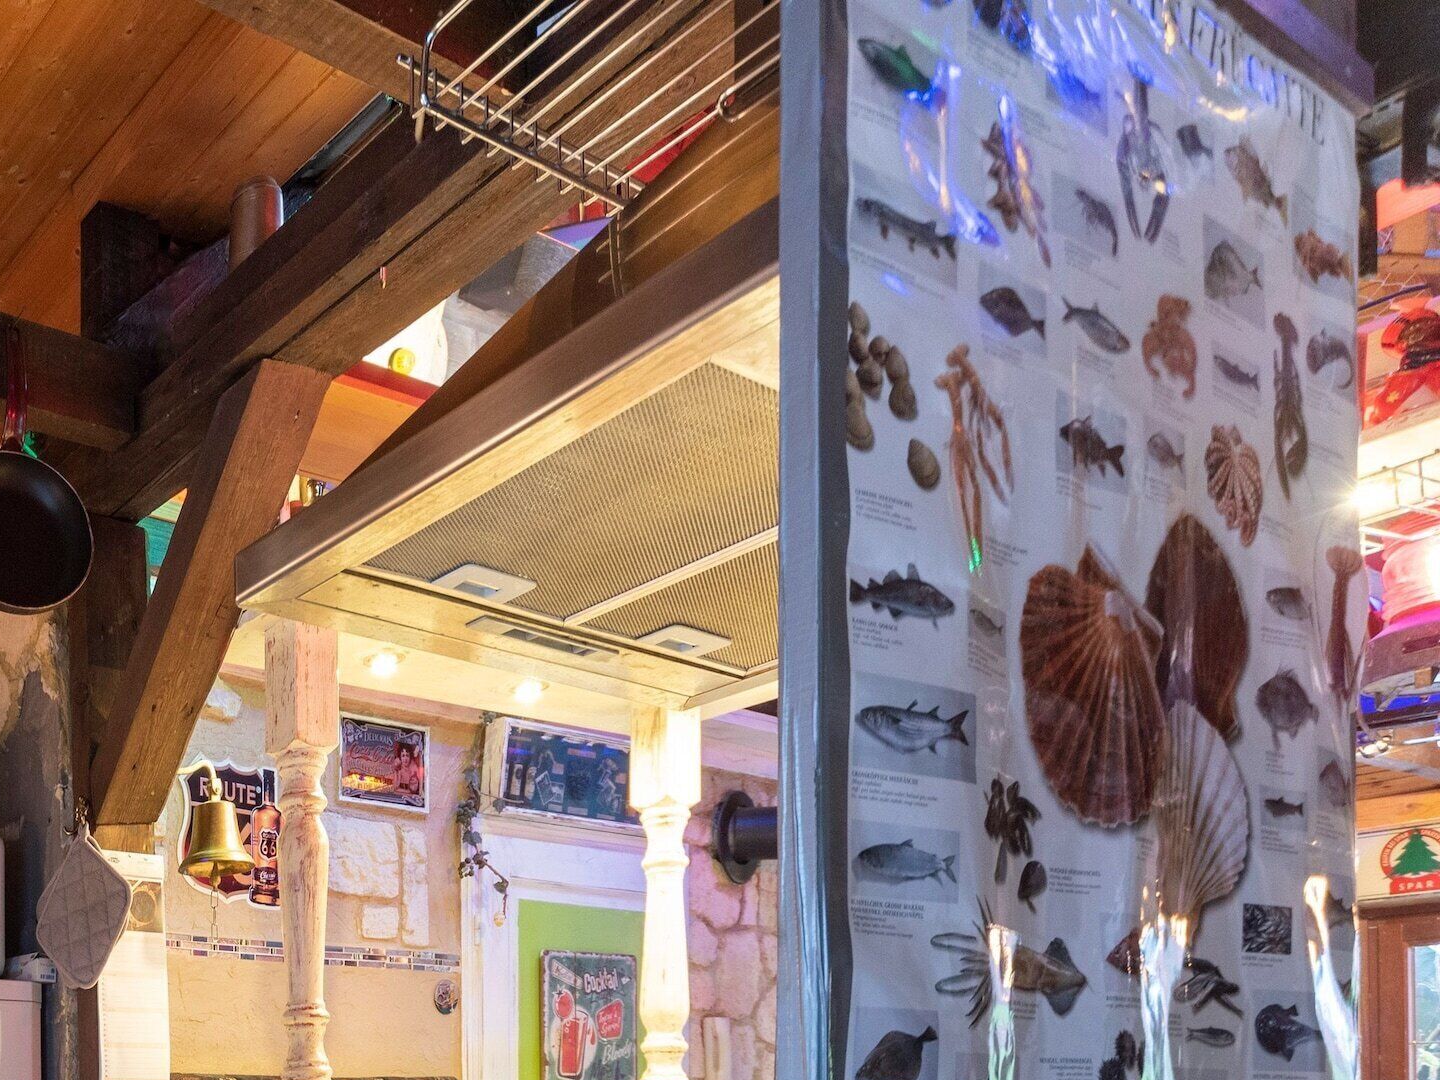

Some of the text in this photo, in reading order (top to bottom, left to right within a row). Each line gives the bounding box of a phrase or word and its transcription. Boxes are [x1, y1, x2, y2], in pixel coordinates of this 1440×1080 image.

[199, 777, 257, 805] RUTE
[261, 840, 277, 855] 66
[1398, 879, 1435, 892] SPAR
[583, 966, 619, 994] Cocktail
[602, 1038, 633, 1066] Bloody
